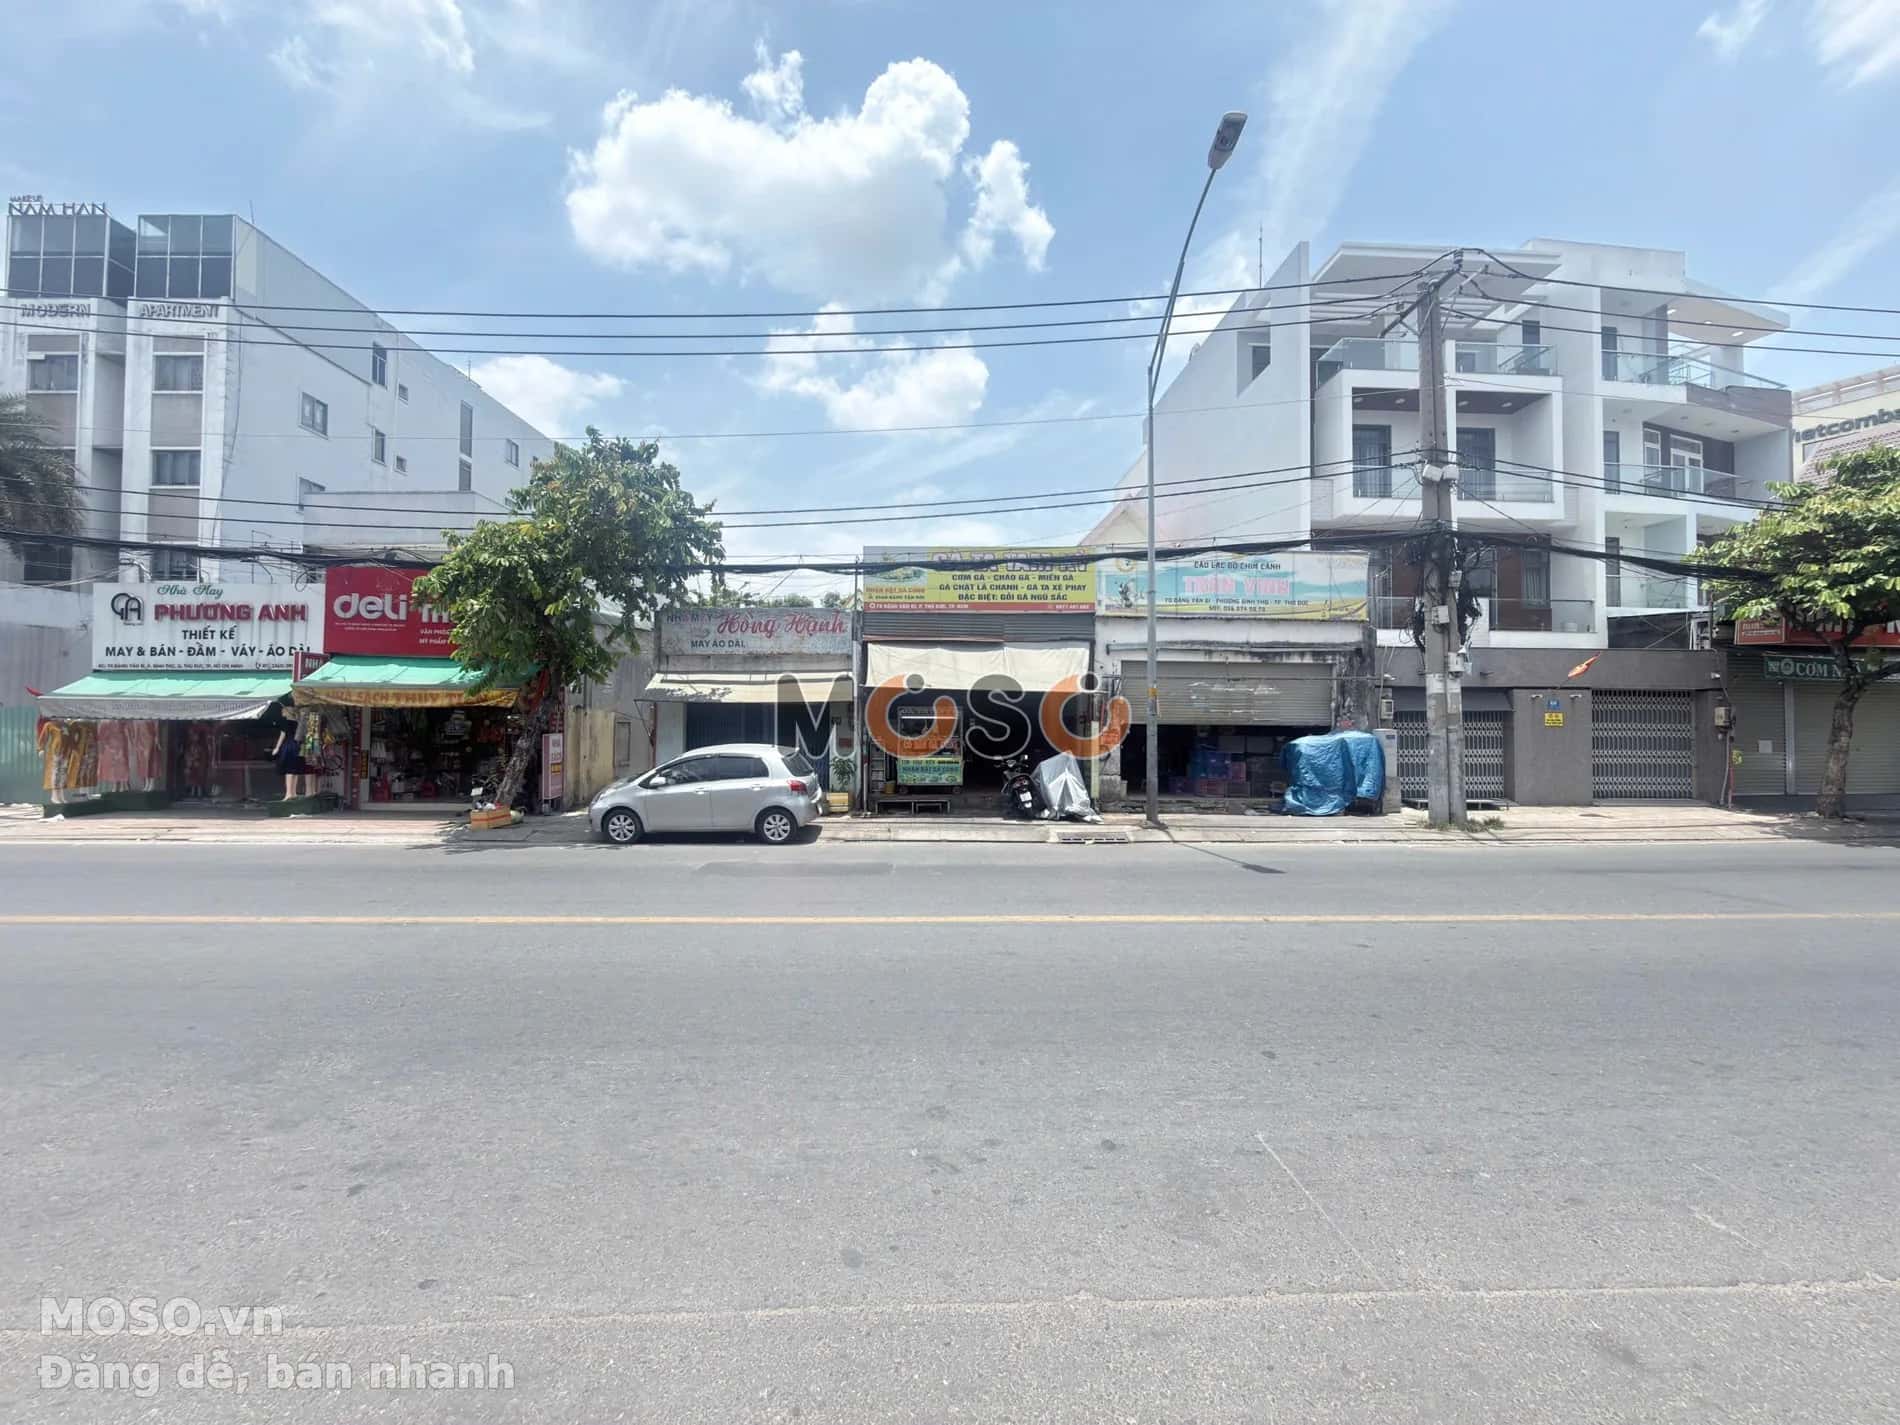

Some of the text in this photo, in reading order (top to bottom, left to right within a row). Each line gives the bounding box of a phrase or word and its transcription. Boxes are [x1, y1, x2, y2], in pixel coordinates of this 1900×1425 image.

[8, 202, 56, 216] NAM
[20, 303, 219, 318] MODERN APARTMENT
[154, 603, 307, 622] PHƯƠNG ANH
[333, 593, 407, 620] deli
[182, 625, 238, 640] THIẾT KẾ
[105, 646, 134, 657] MAY
[136, 646, 145, 657] &
[150, 643, 176, 657] BÁN
[187, 642, 216, 657] ĐẦM
[231, 643, 256, 657] VÁY
[266, 644, 285, 657] ÁO
[690, 640, 710, 648] MAY
